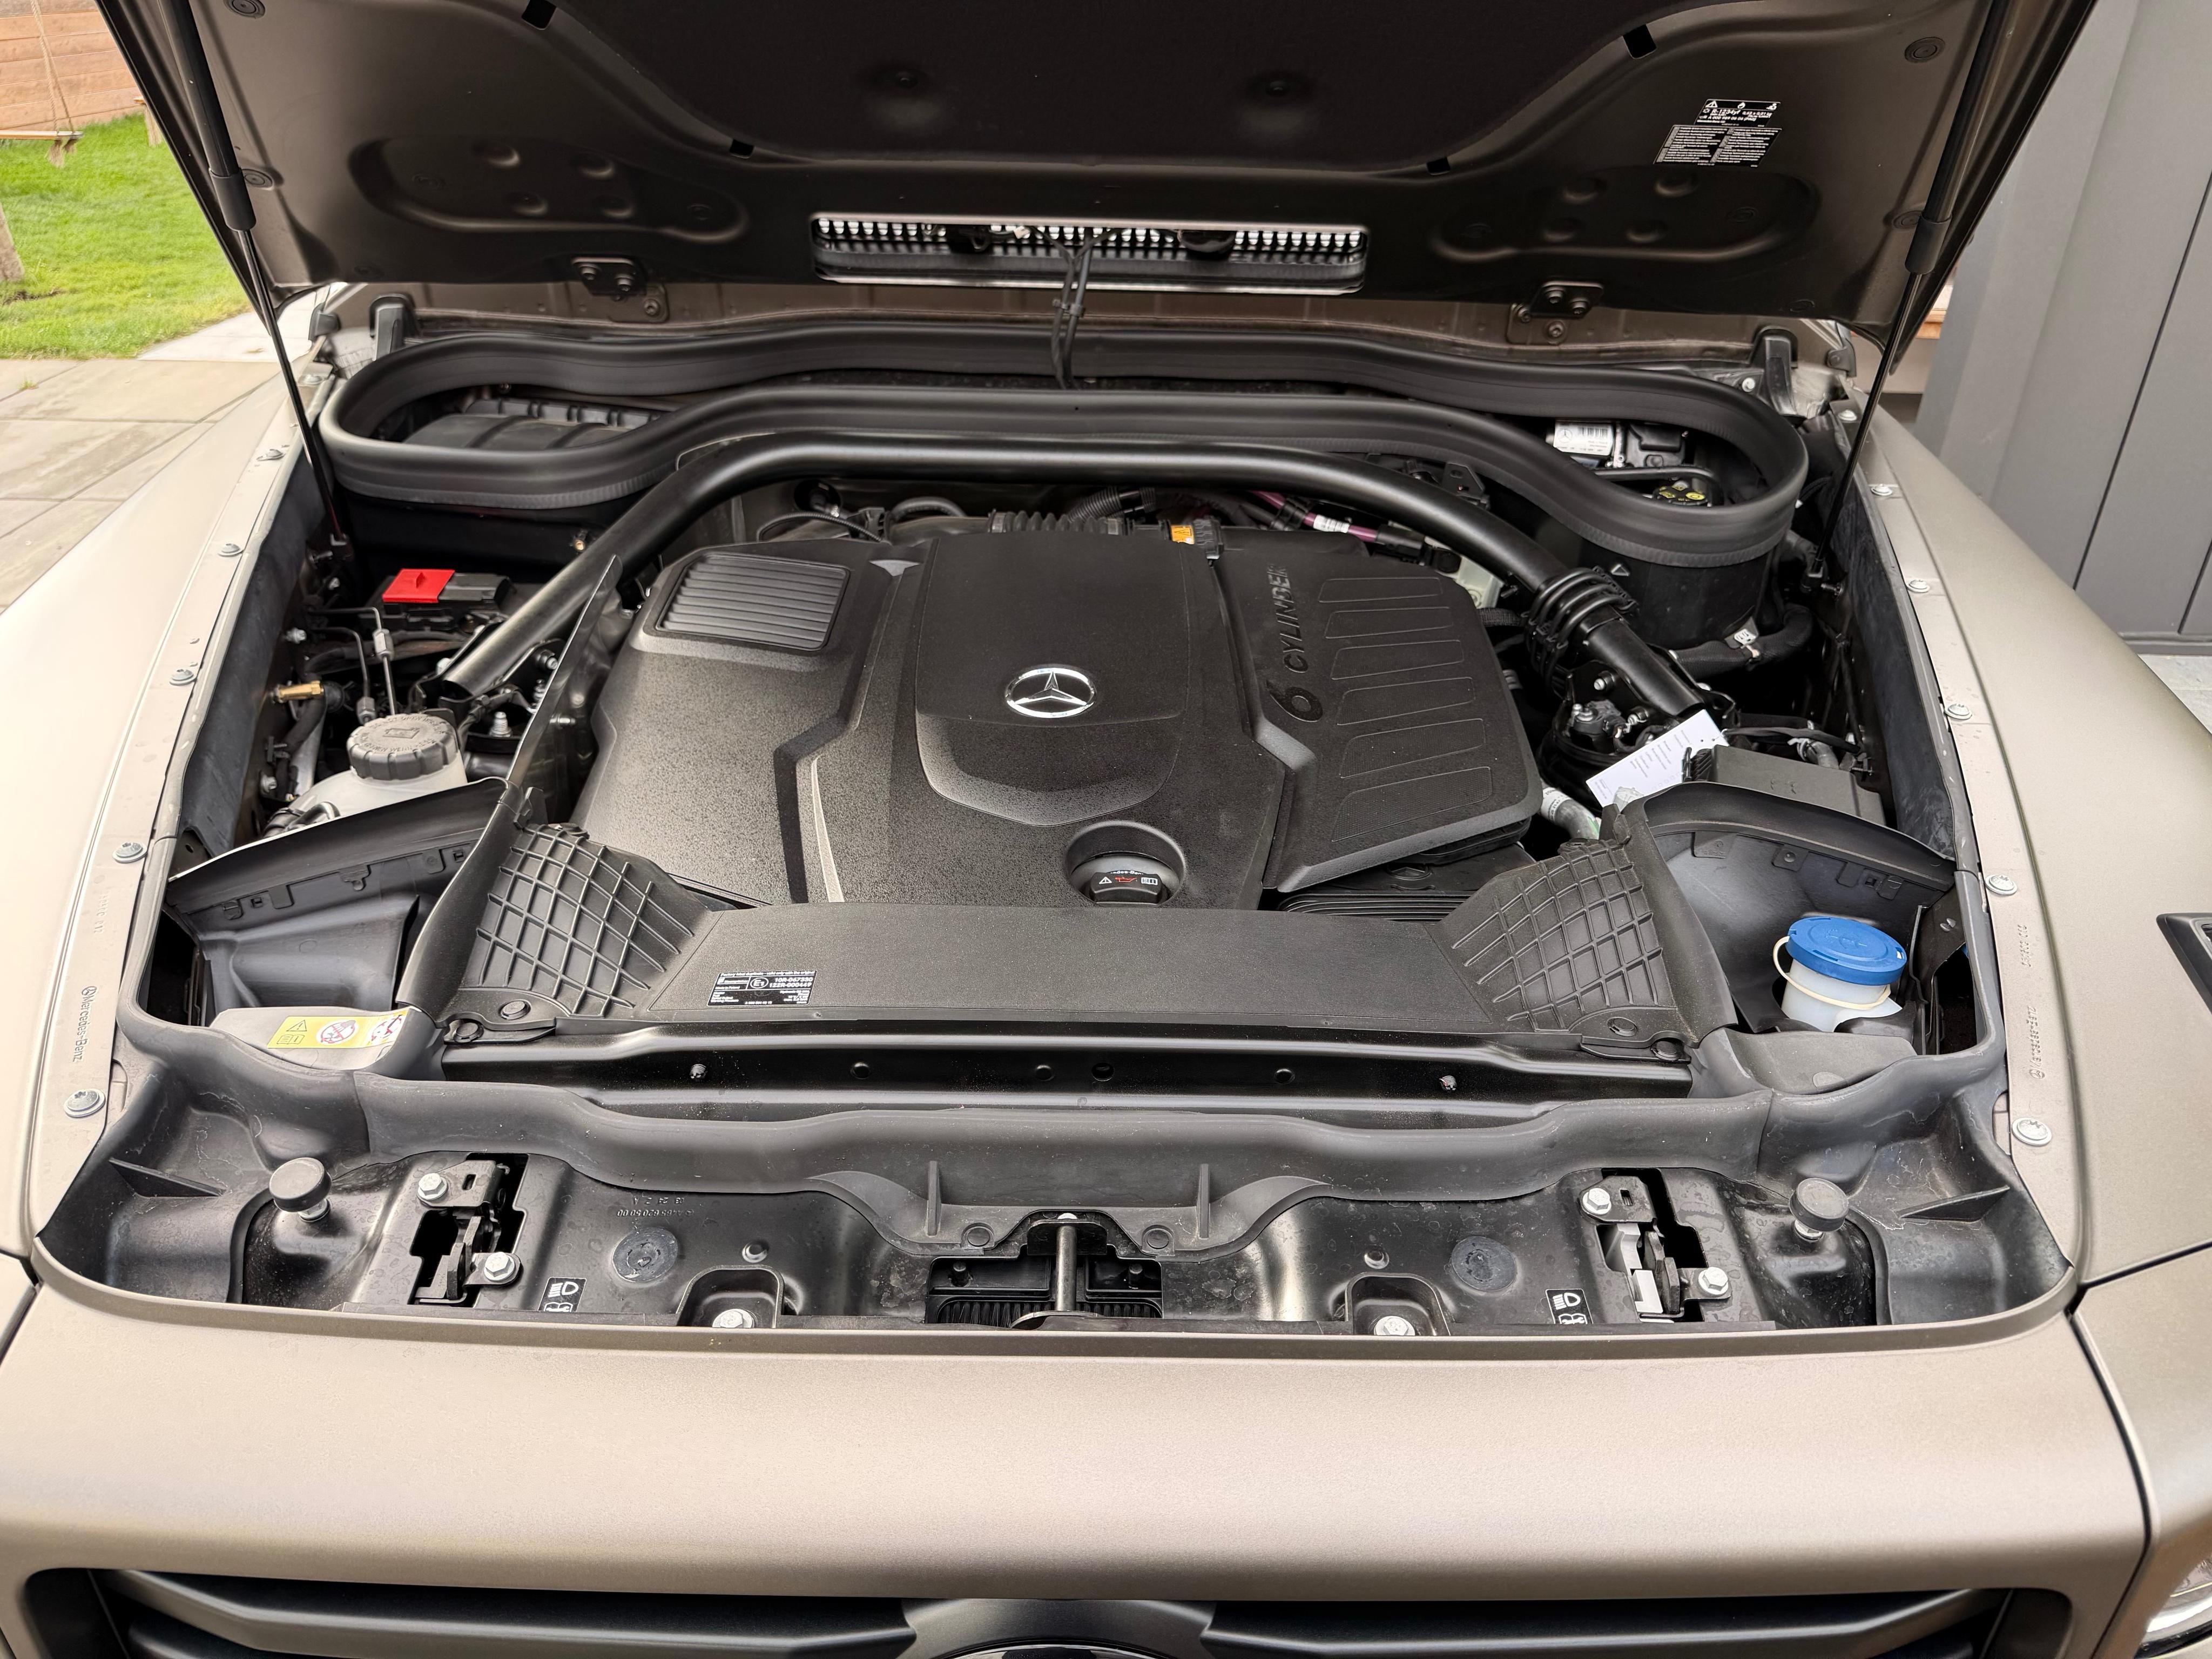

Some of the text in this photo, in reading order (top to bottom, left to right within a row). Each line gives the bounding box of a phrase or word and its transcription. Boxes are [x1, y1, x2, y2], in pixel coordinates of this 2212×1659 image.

[1266, 564, 1323, 723] 6 CYLINDER
[72, 996, 95, 1063] Mercedes-Benz
[2027, 1006, 2042, 1069] Mercedes-Benz
